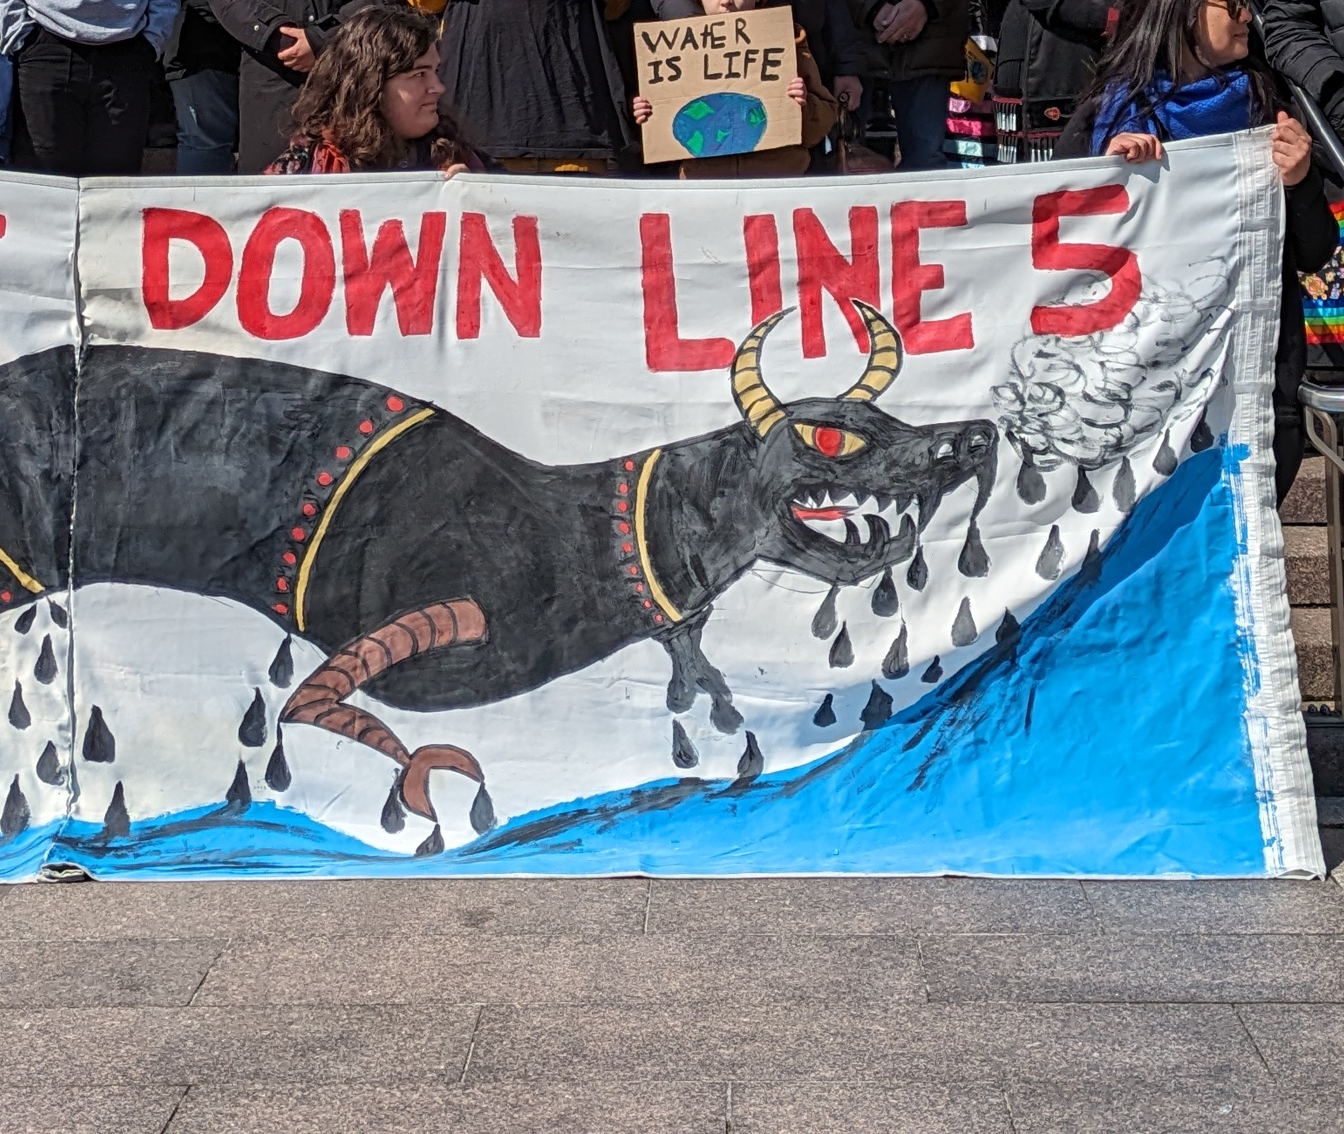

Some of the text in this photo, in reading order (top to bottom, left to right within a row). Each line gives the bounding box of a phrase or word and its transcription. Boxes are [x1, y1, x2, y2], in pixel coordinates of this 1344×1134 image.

[647, 47, 785, 85] IS LIFE
[139, 206, 543, 341] DOWN
[638, 199, 974, 373] LINE
[1028, 182, 1143, 337] 5
